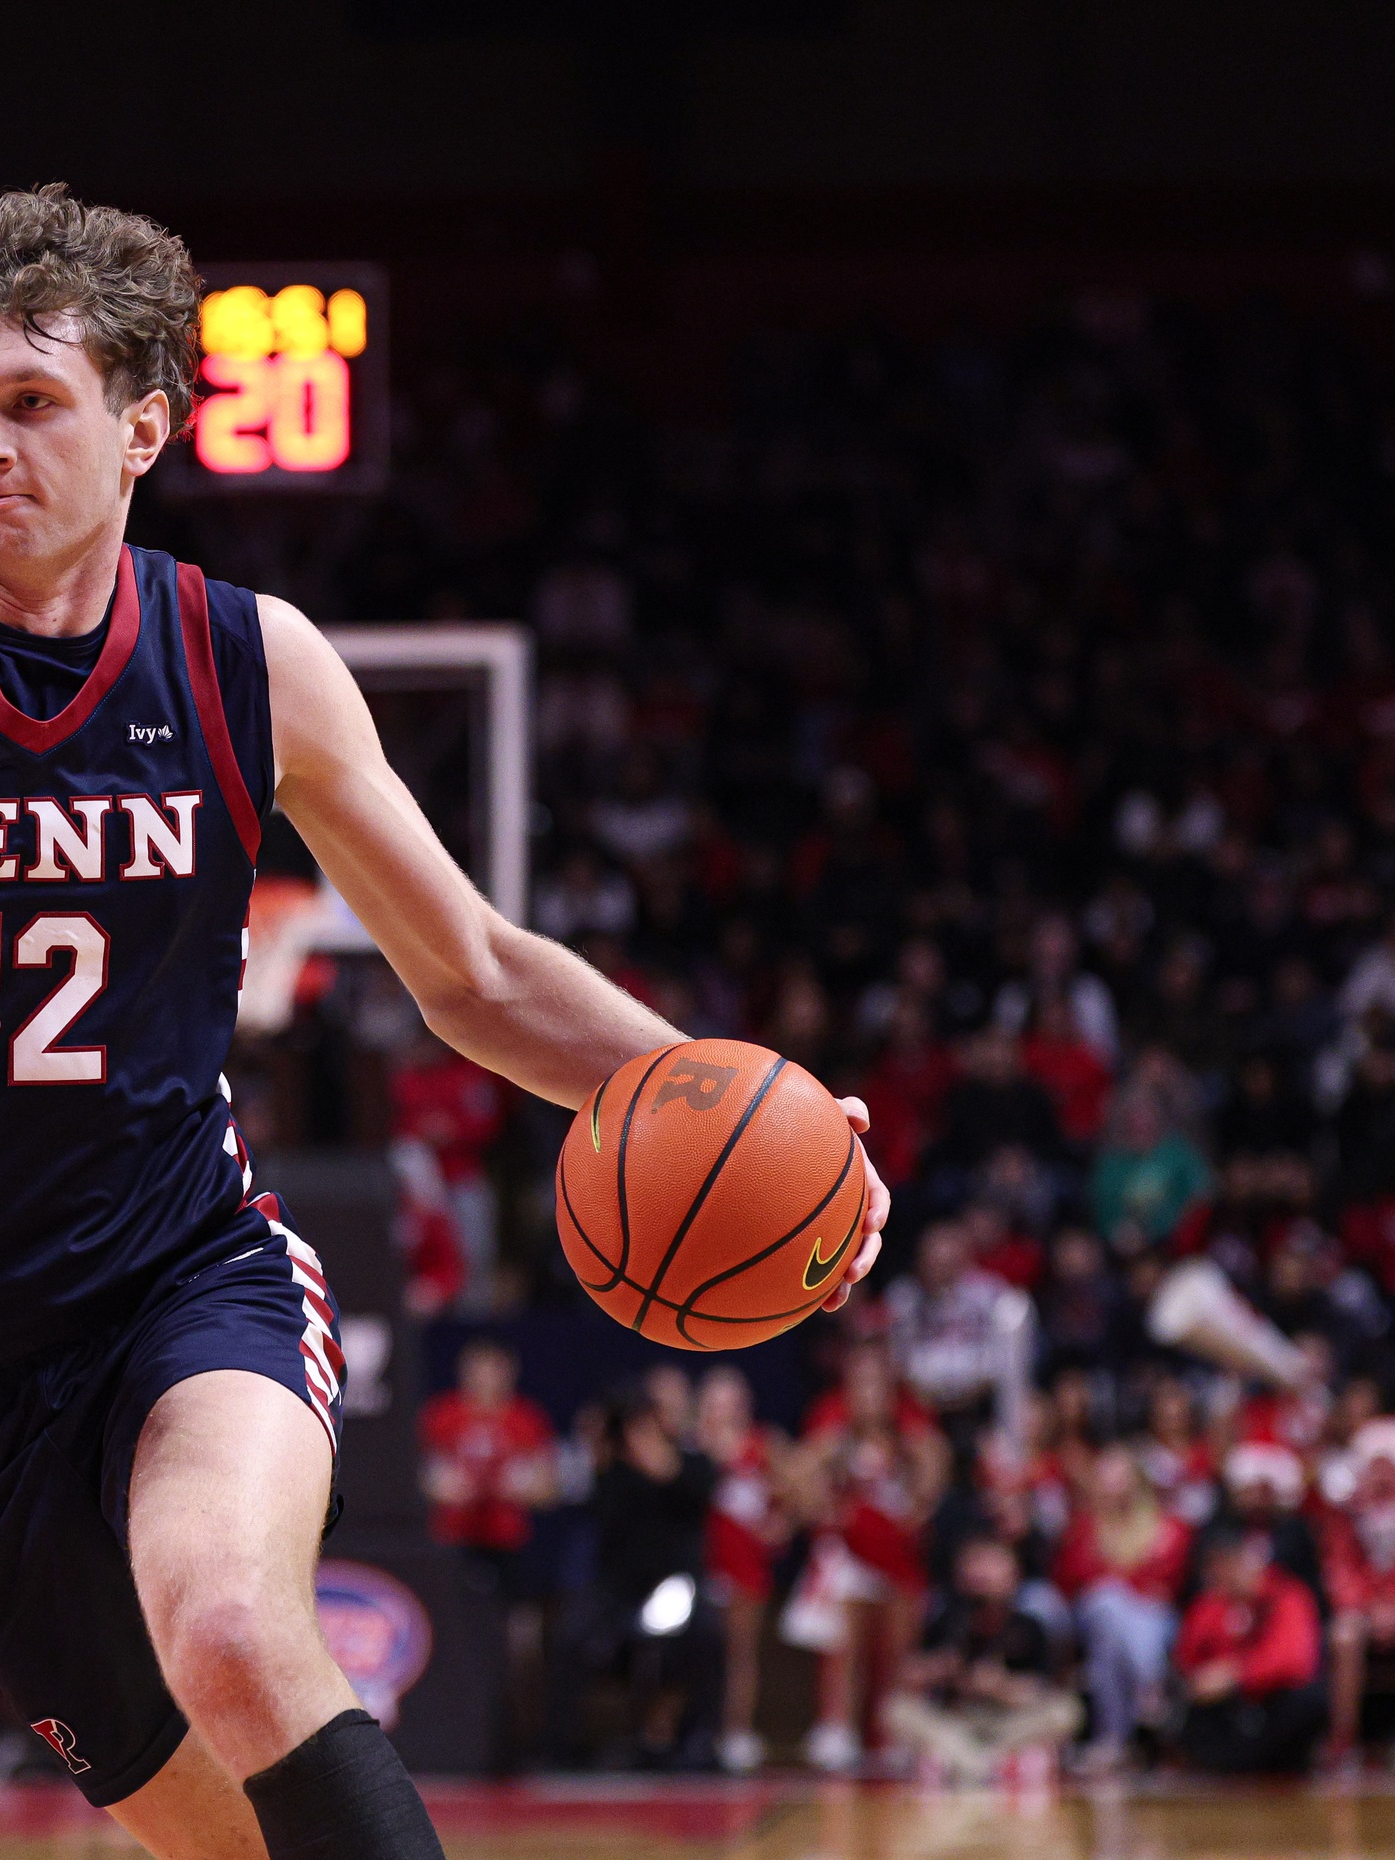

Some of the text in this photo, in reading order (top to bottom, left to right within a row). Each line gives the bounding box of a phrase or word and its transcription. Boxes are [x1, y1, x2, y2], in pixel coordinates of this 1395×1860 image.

[196, 350, 350, 474] 20
[128, 724, 157, 744] Ivy
[651, 1057, 737, 1114] R
